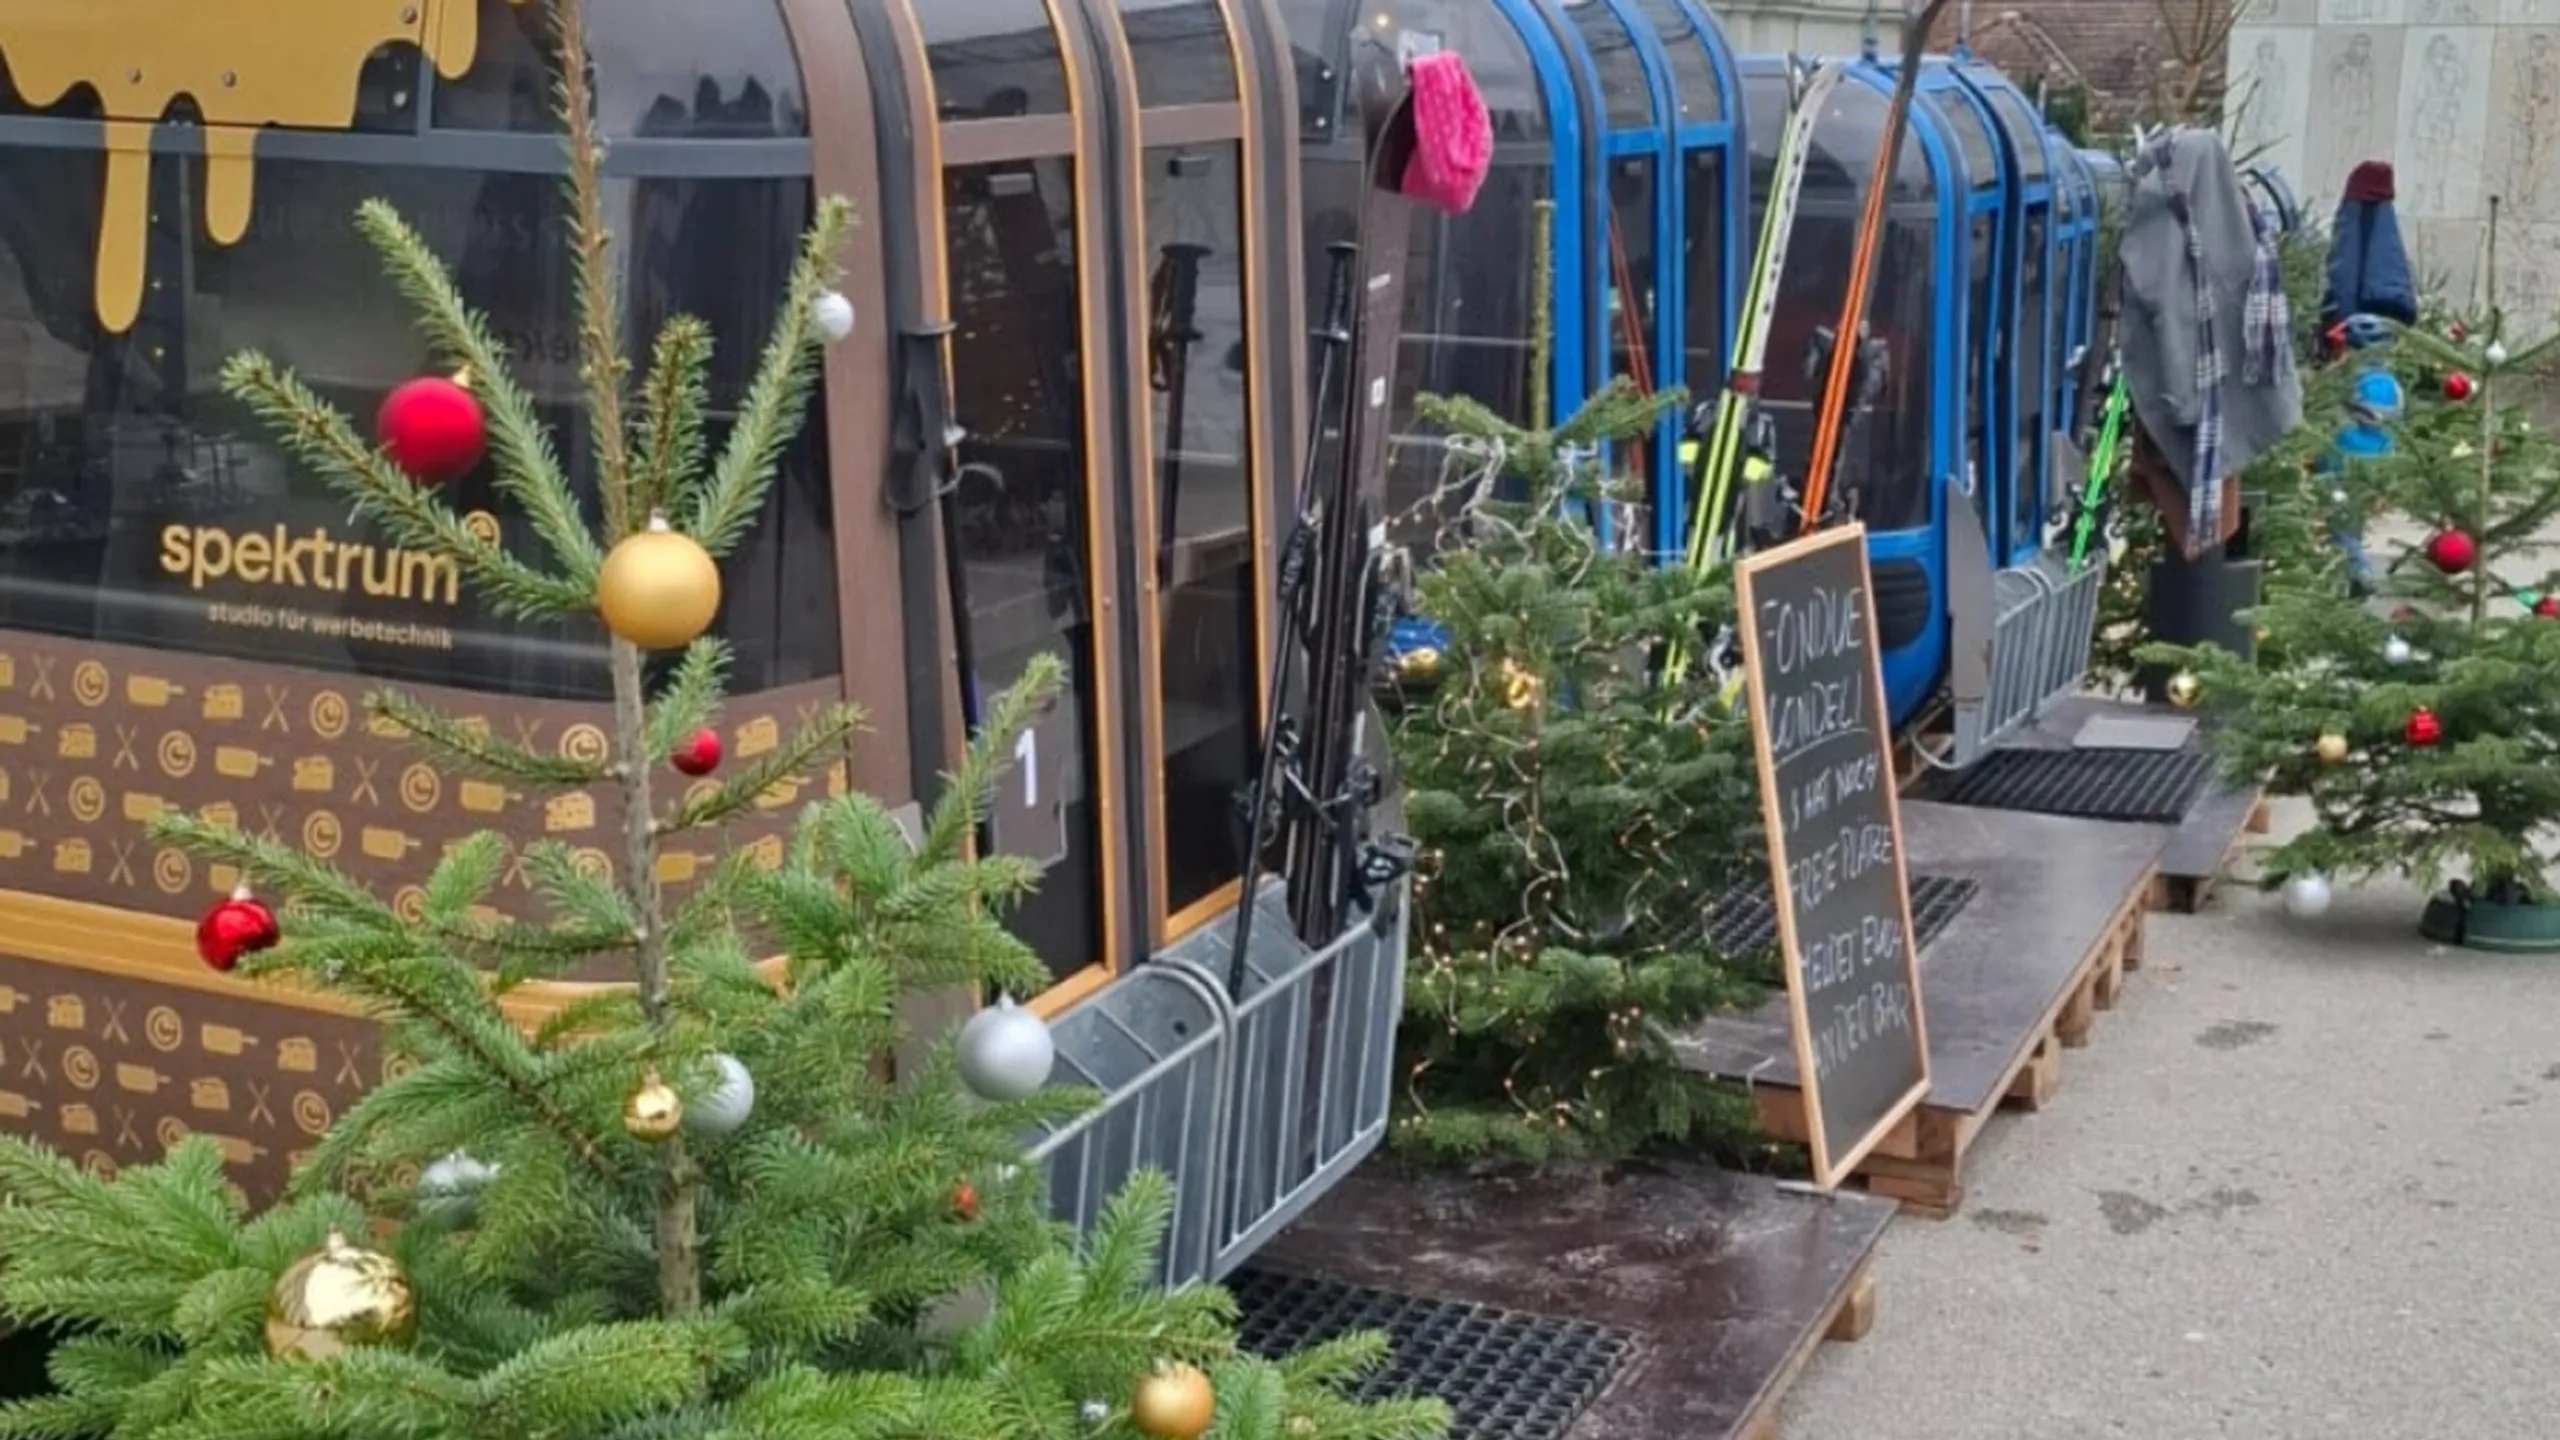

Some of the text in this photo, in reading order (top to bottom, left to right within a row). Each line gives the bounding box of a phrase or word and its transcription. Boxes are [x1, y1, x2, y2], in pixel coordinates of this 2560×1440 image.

[160, 523, 460, 604] spektrum
[208, 602, 452, 650] studio für werbetechnik
[1762, 585, 1862, 675] FONDUE
[1015, 727, 1036, 808] 1
[1870, 981, 1911, 1037] BAR
